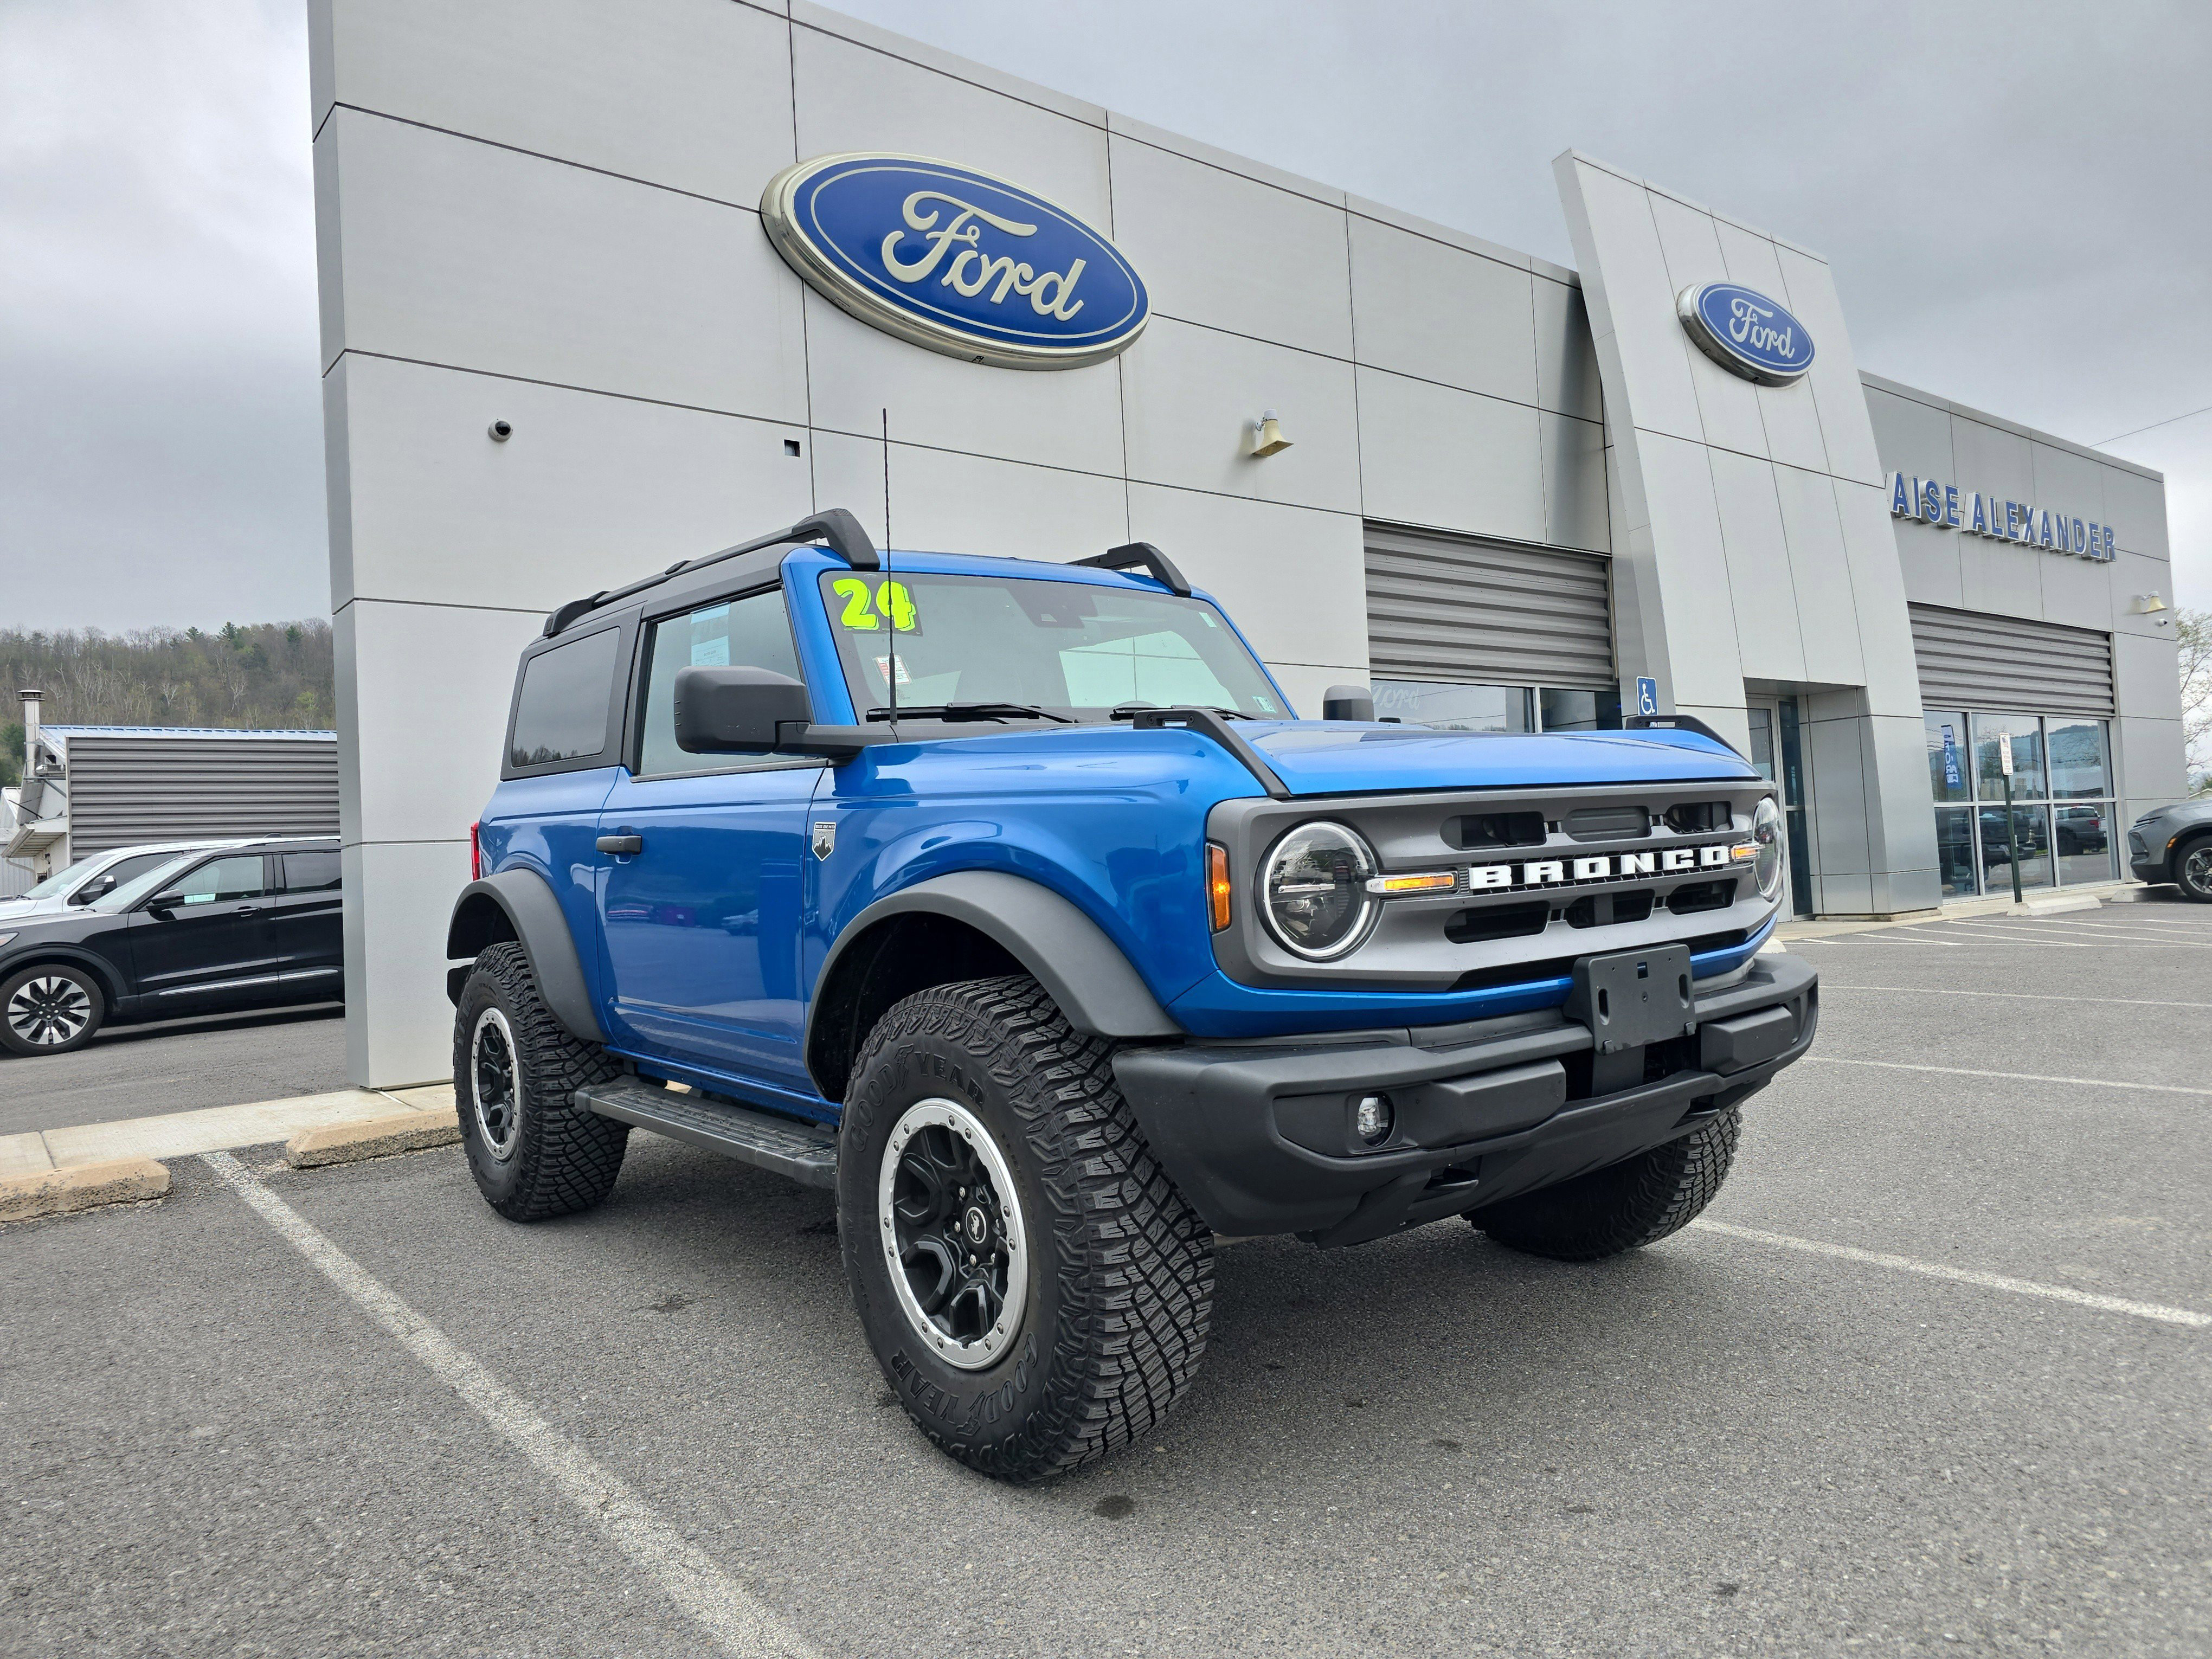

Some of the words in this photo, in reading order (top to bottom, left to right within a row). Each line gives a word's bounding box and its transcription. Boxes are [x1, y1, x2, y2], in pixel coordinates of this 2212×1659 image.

[882, 191, 1086, 321] Ford
[1729, 298, 1795, 358] Ford
[1888, 471, 1960, 528] AISE
[1964, 492, 2117, 562] ALEXANDER
[832, 578, 916, 632] 24
[1469, 846, 1729, 890] BRONCO
